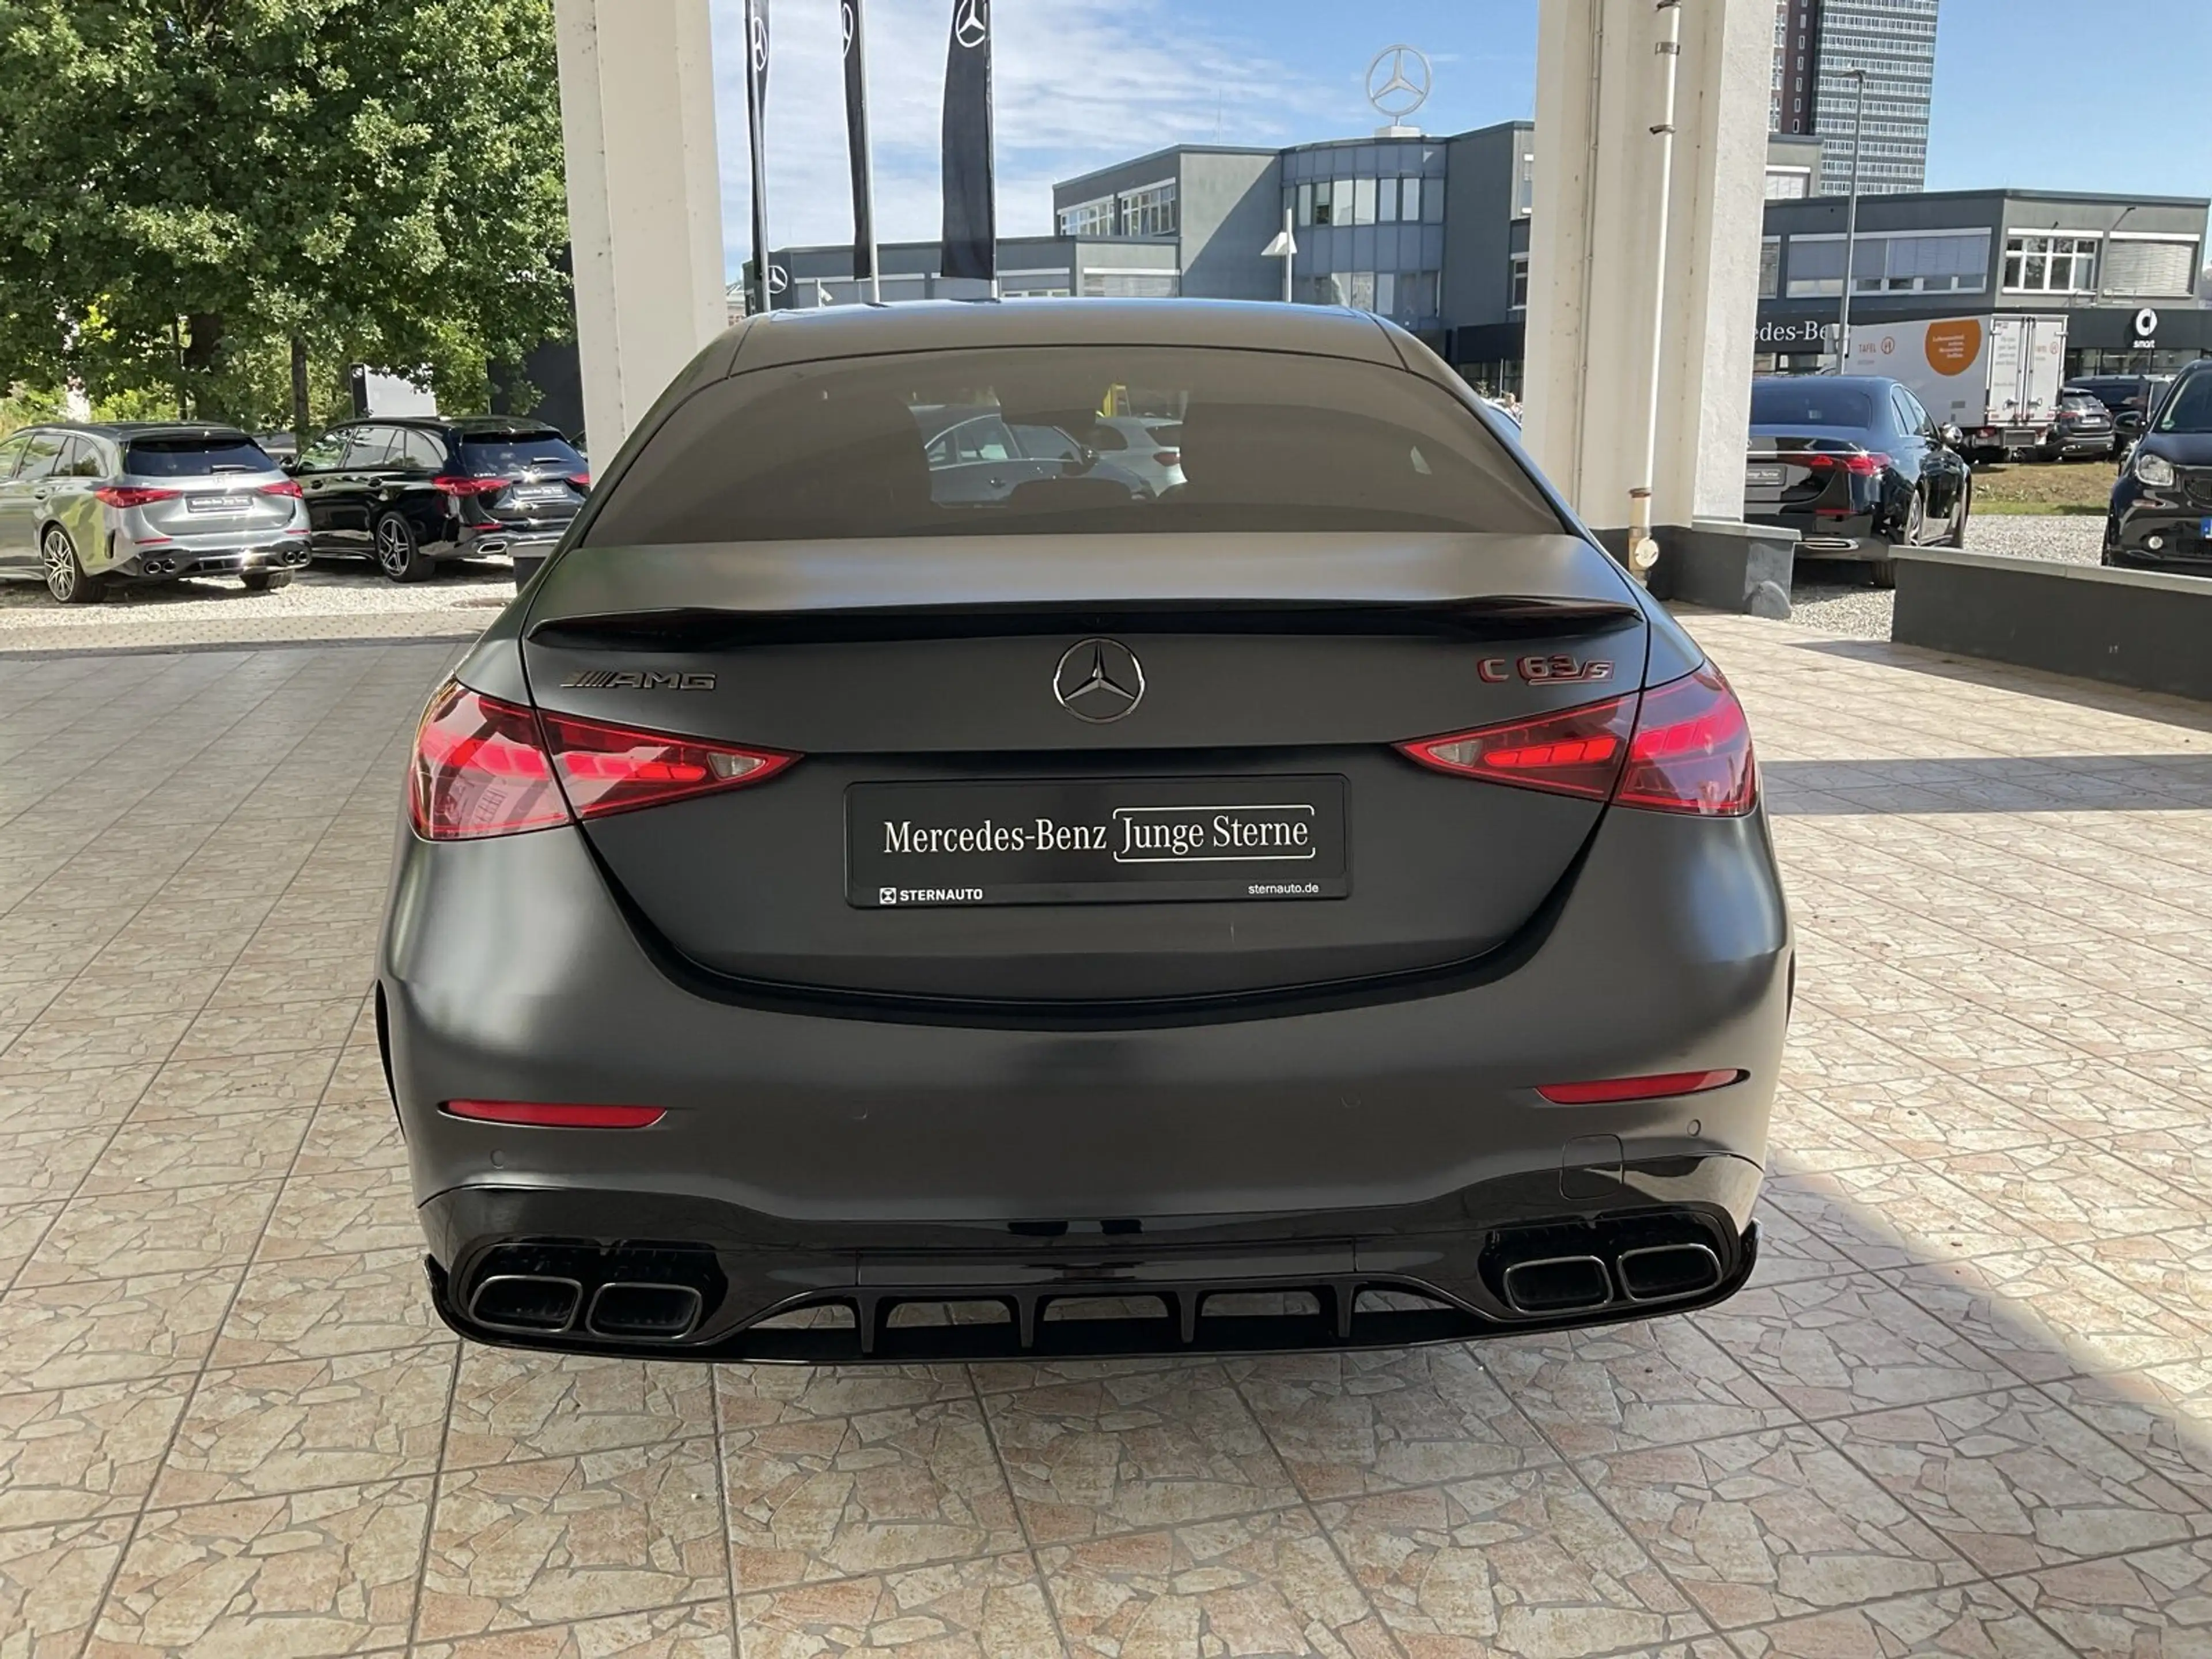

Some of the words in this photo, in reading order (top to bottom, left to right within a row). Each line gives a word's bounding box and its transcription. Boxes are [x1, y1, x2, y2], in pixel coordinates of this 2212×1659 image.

[1477, 658, 1509, 683] C
[604, 671, 717, 690] AMG
[883, 819, 1107, 853] Mercedes-Benz
[1121, 817, 1204, 855] Junge
[1213, 815, 1308, 847] Sterne
[899, 888, 983, 902] STERNAUTO
[1248, 882, 1319, 894] sternauto.de
